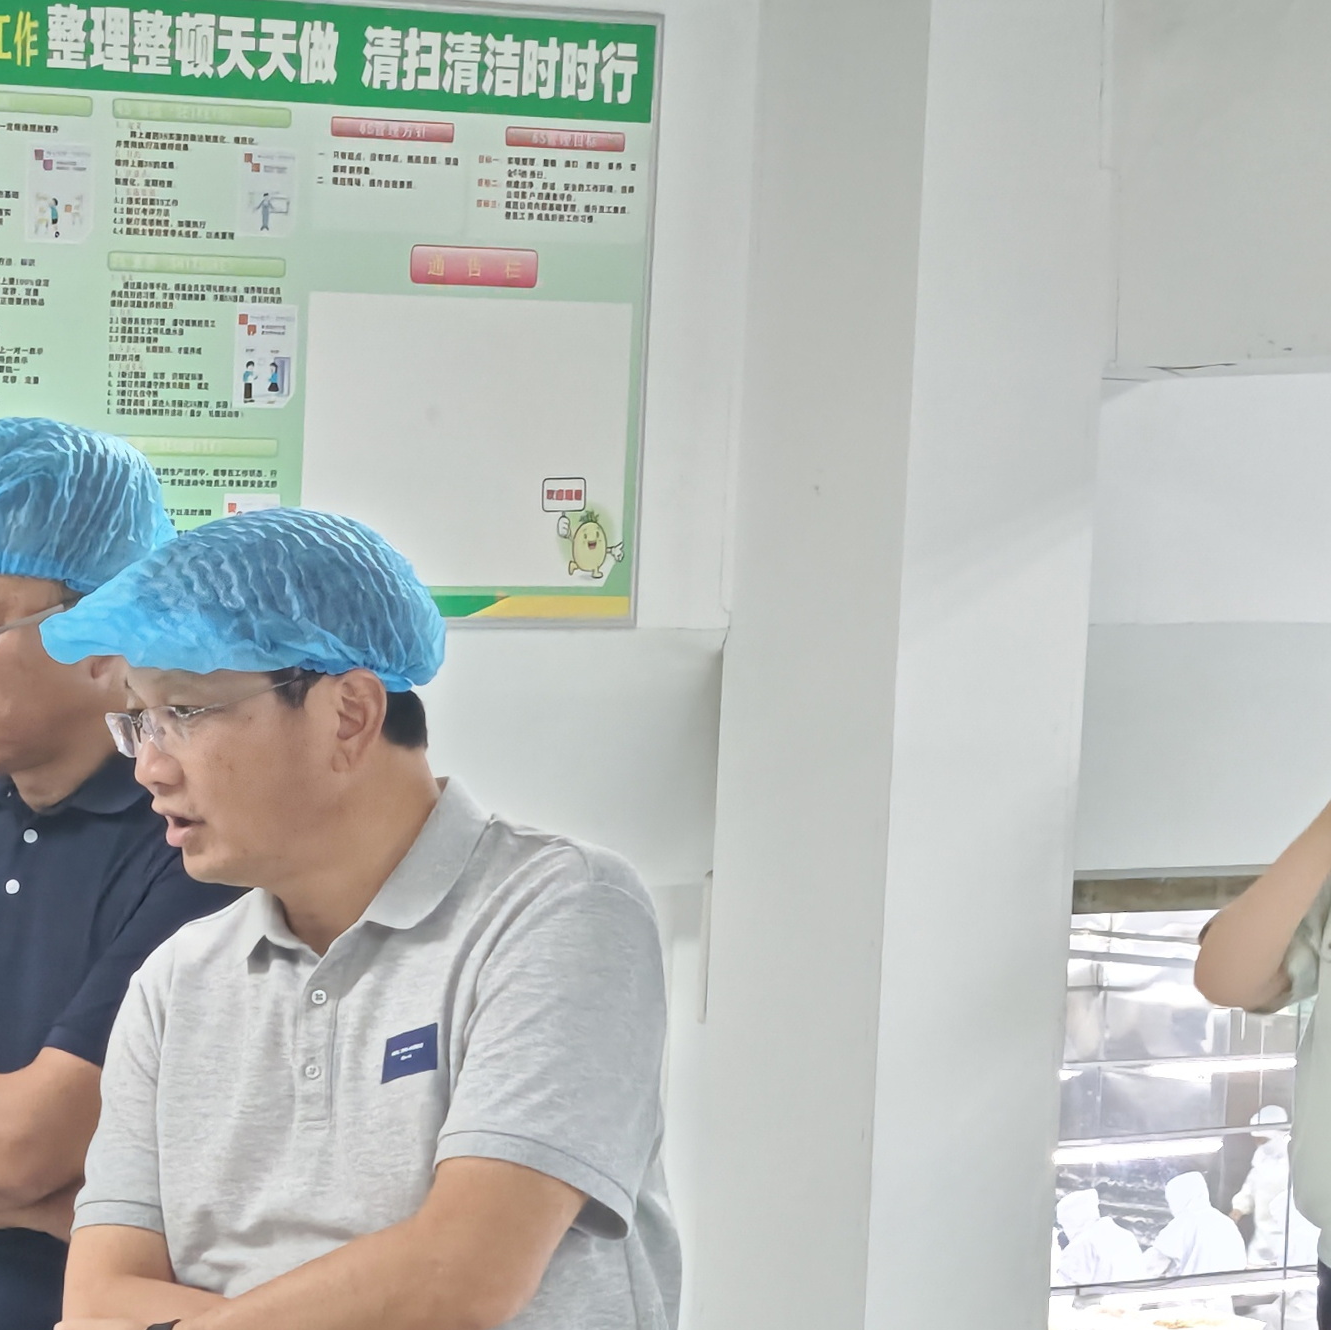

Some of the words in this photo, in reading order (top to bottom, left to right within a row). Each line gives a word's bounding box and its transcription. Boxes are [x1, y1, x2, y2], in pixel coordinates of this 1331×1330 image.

[46, 3, 339, 86] 整理整顿天天做
[360, 25, 638, 105] 清扫清洁时时行
